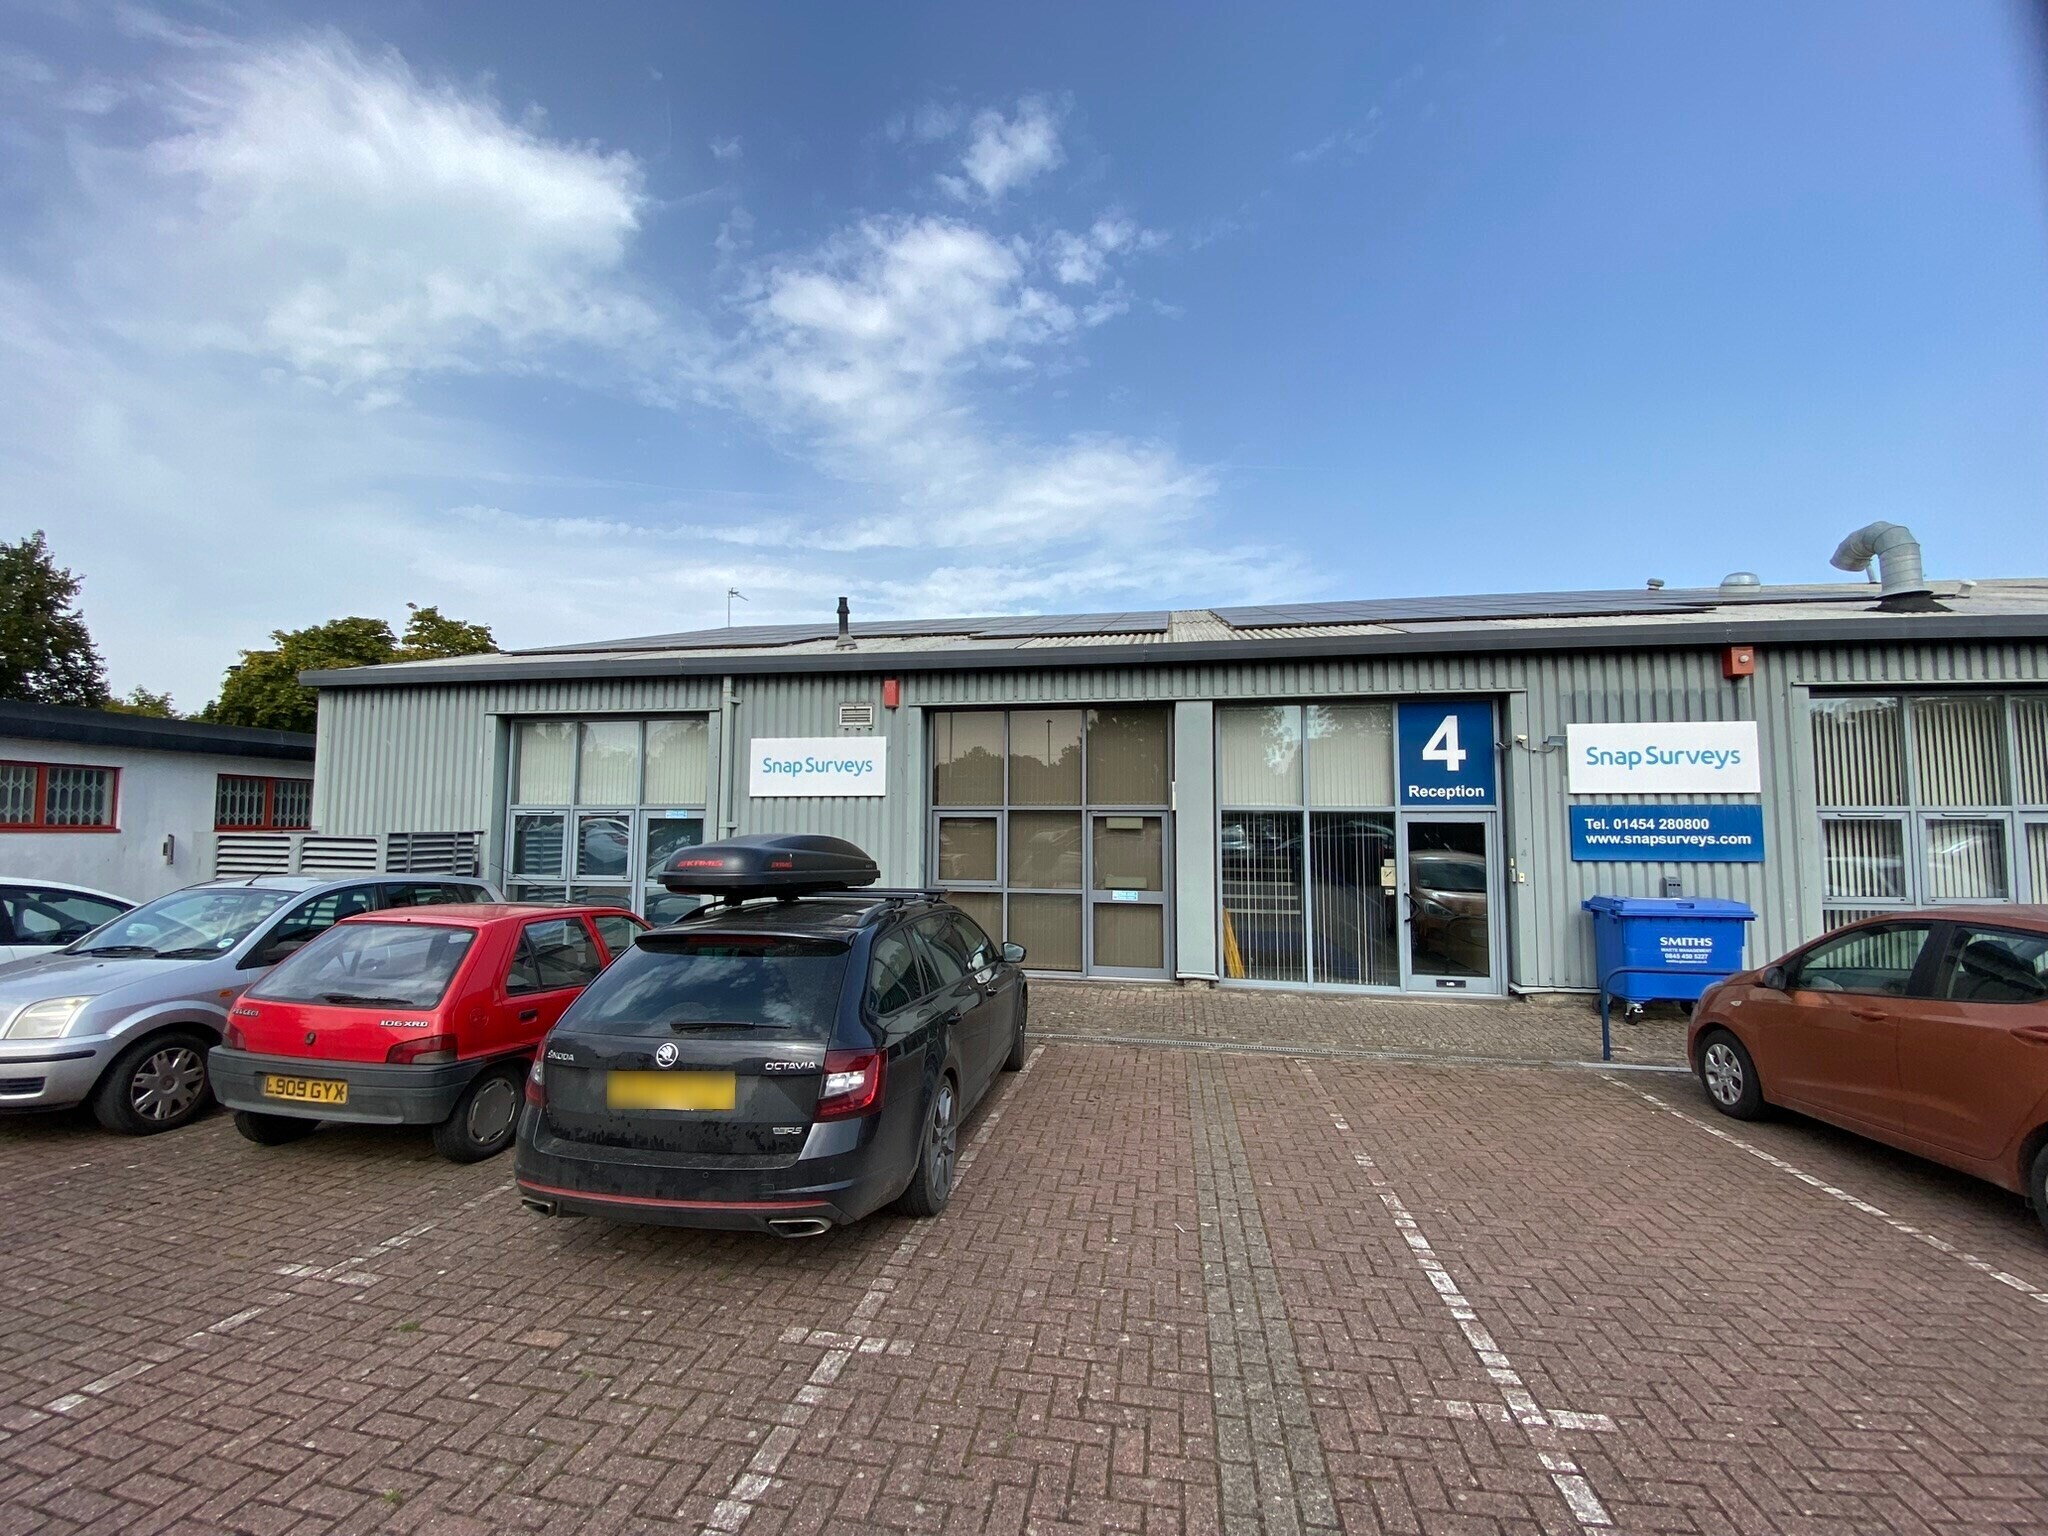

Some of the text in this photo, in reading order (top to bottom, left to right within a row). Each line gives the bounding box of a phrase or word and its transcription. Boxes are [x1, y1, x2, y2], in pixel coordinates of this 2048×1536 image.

[1422, 714, 1467, 772] 4
[1586, 745, 1741, 770] Snap Surveys
[762, 756, 873, 777] Snap Surveys
[1408, 784, 1485, 800] Reception
[1584, 818, 1709, 830] Tel. 01454 280800
[1585, 834, 1752, 847] www.snapsurveys.com
[1659, 936, 1713, 947] SMITHS
[765, 1061, 816, 1071] OCTAVIA
[265, 1076, 346, 1101] L909 GYX
